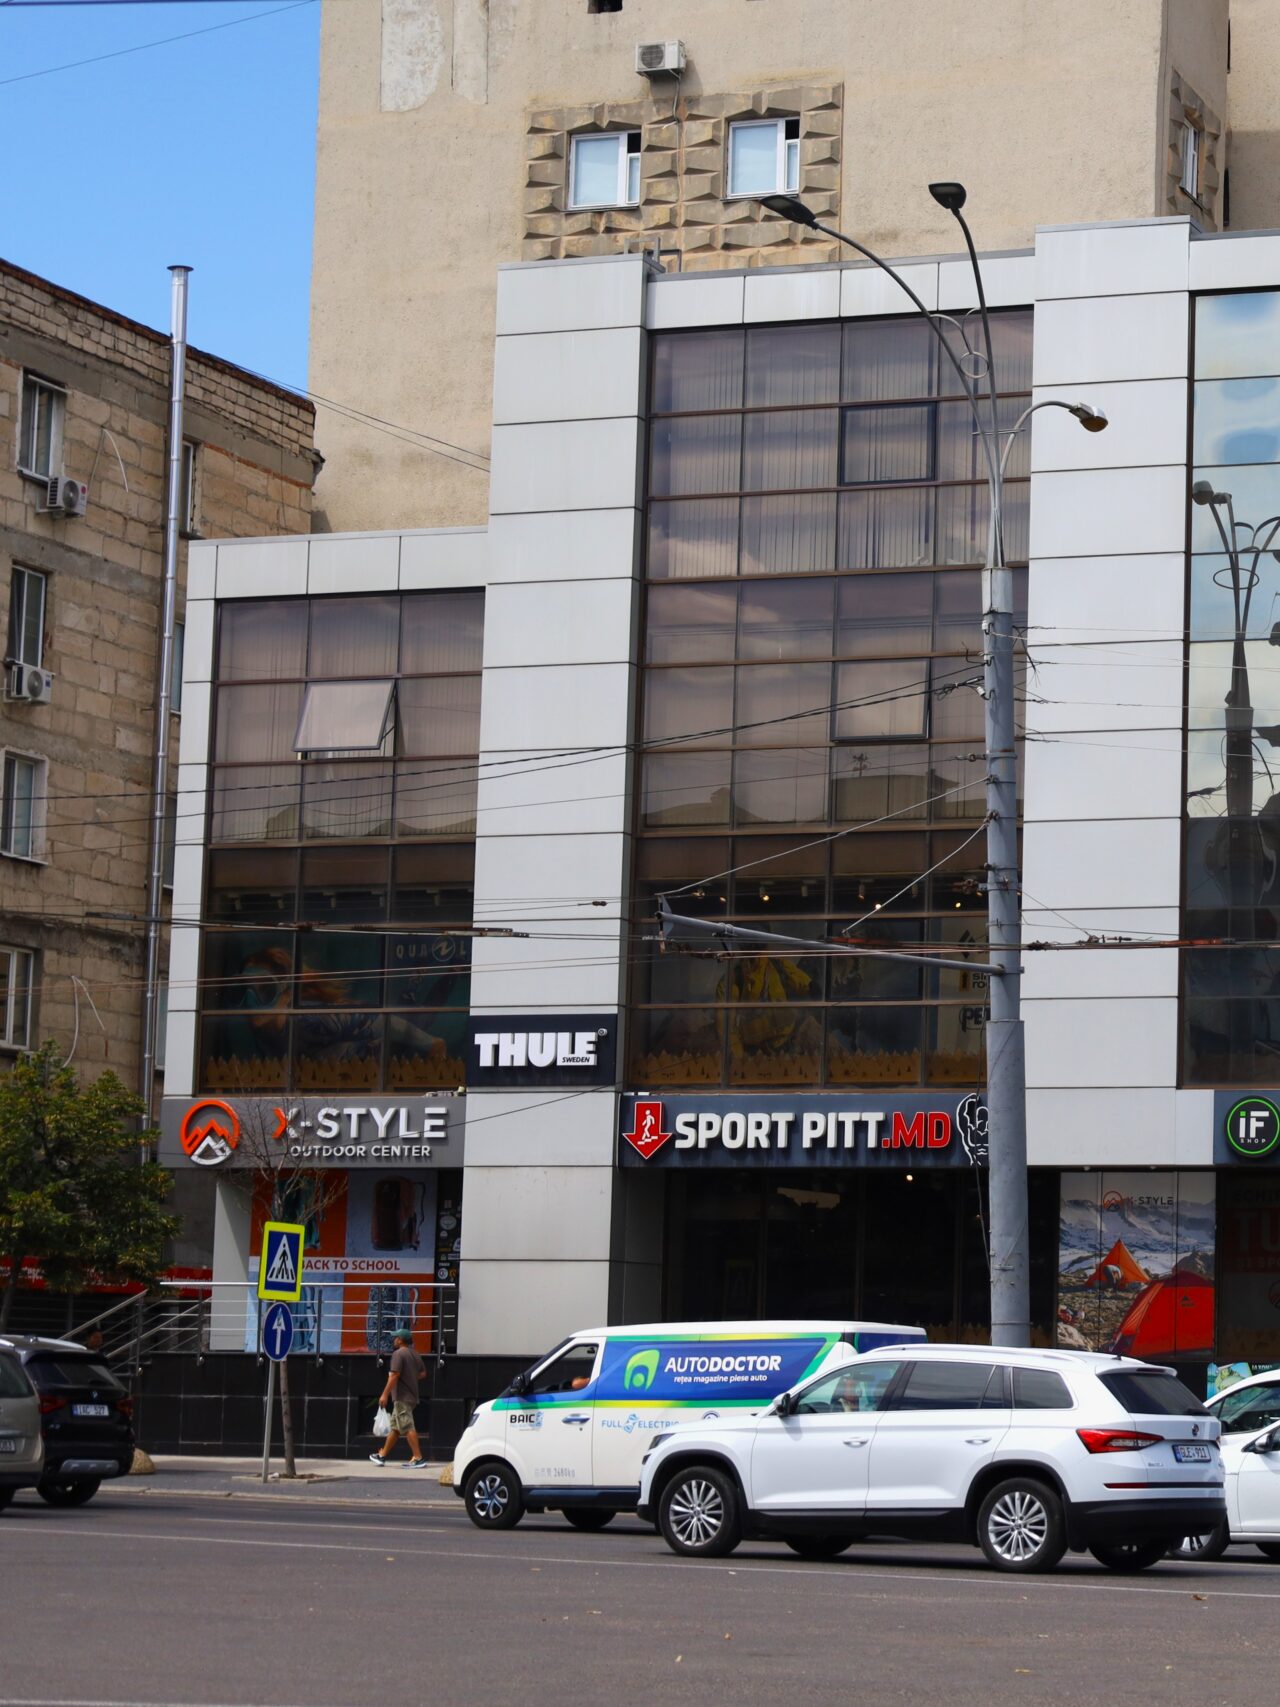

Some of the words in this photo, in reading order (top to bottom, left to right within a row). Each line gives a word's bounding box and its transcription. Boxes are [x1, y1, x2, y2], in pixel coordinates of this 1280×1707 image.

[474, 1032, 597, 1067] THULE
[272, 1107, 448, 1139] X-STYLE
[675, 1113, 795, 1148] SPORT
[803, 1112, 950, 1148] PITT.MD
[290, 1145, 366, 1157] OUTDOOR
[371, 1145, 431, 1156] CENTER
[332, 1260, 349, 1270] TO
[352, 1260, 400, 1270] SCHOOL
[664, 1355, 782, 1373] AUTODOCTOR
[693, 1375, 729, 1384] magazine
[750, 1374, 768, 1382] auto
[510, 1413, 535, 1424] BAIC
[601, 1420, 622, 1428] FULL
